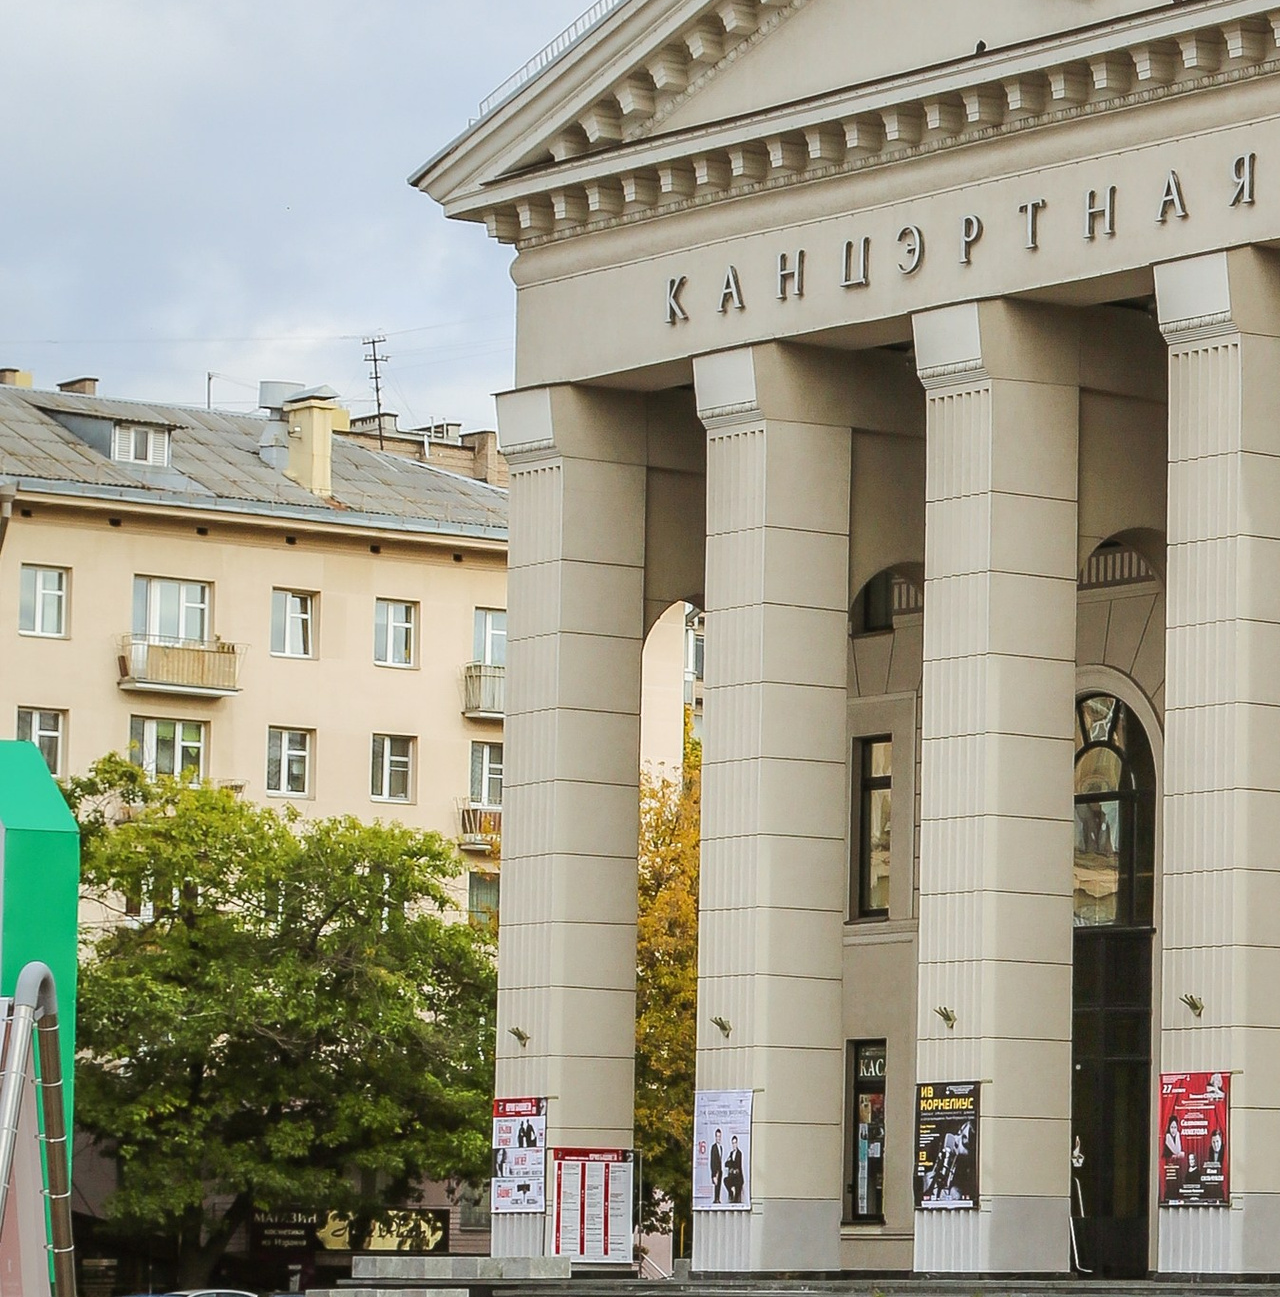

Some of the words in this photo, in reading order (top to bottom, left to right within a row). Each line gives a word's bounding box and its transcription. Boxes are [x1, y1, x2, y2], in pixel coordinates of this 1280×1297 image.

[664, 151, 1257, 325] КАНЦЭРТНАЯ
[859, 1058, 886, 1076] КАС
[920, 1086, 934, 1098] ИВ
[1162, 1084, 1173, 1094] 27
[920, 1097, 975, 1111] КОРНЕЛИУС
